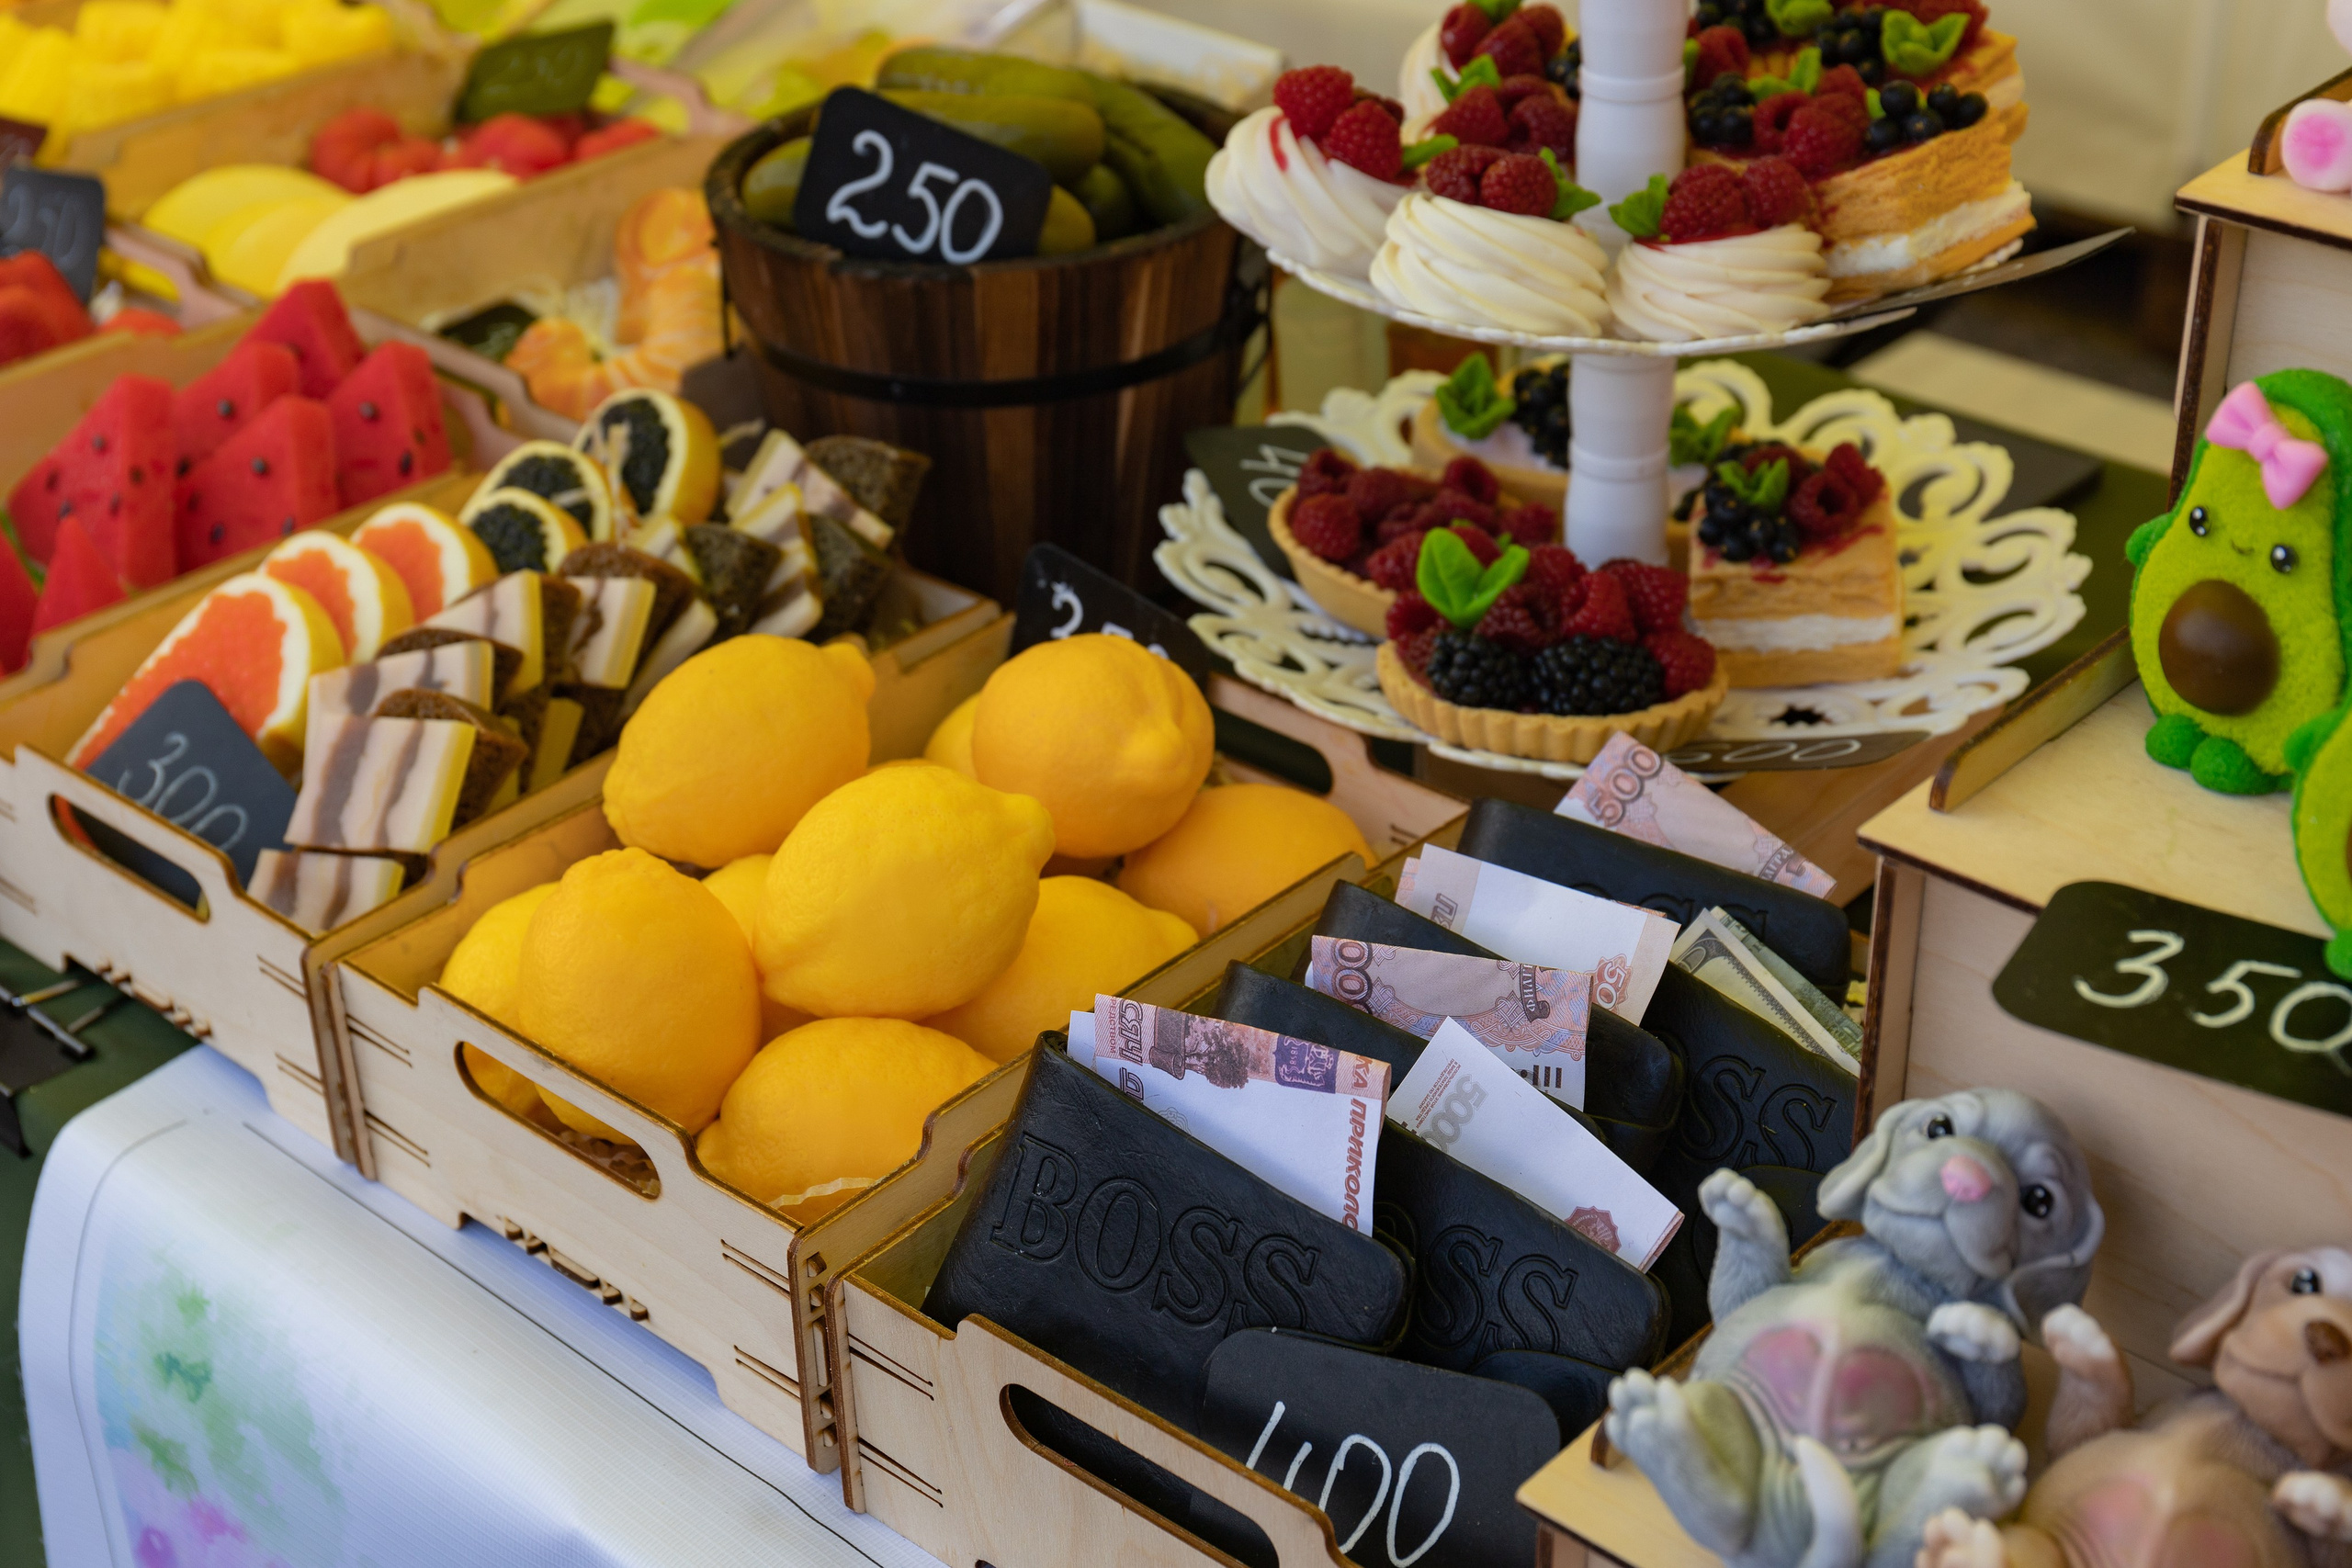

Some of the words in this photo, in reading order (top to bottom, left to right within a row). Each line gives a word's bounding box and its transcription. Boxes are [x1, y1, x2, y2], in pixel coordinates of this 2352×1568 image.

[826, 129, 1003, 265] 250
[117, 731, 249, 853] 300
[1587, 742, 1663, 826] 500
[1330, 937, 1374, 1015] 00
[2073, 929, 2352, 1054] 350
[990, 1131, 1321, 1337] BOSS
[1247, 1401, 1460, 1567] 400
